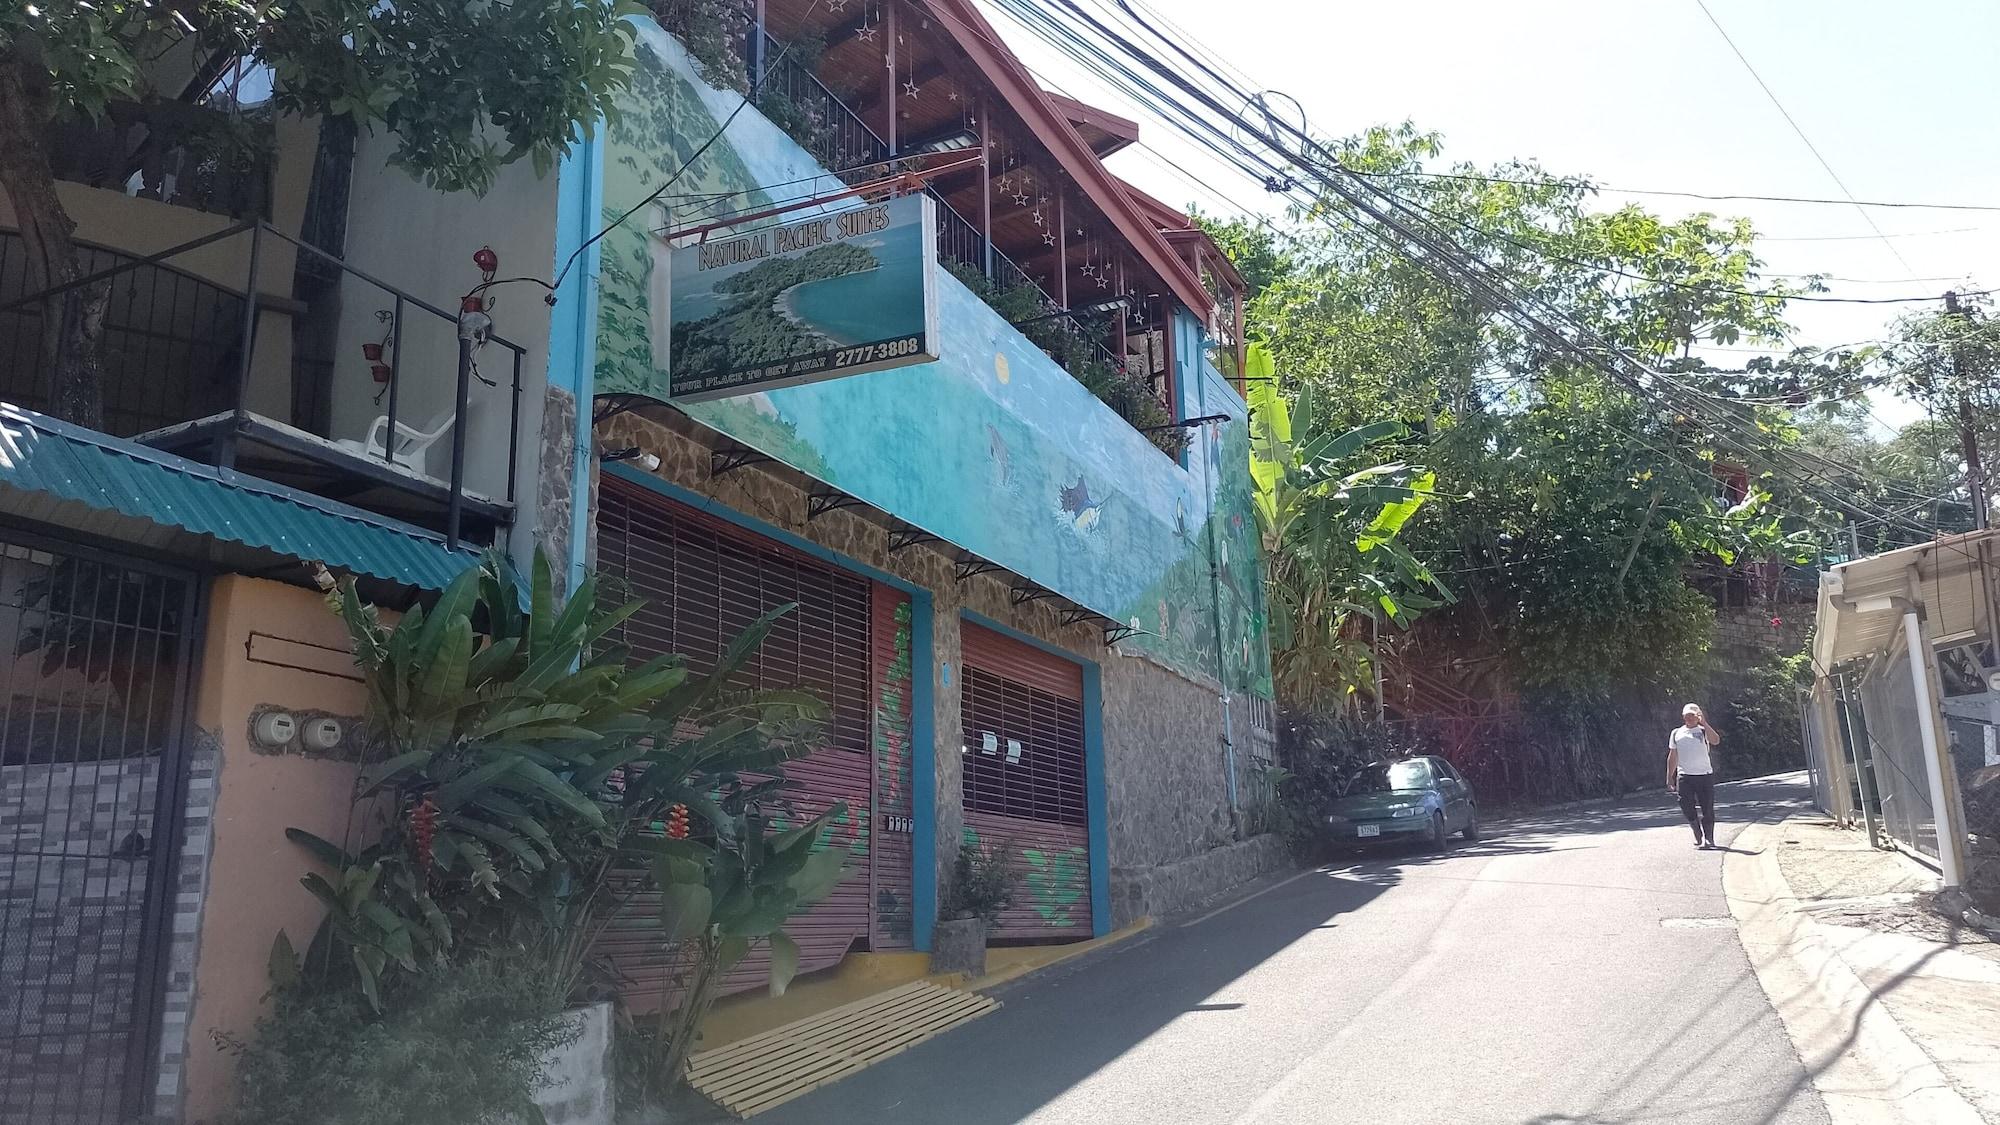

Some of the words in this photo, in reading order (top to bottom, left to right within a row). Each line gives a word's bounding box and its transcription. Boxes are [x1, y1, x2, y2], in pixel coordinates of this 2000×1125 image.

[699, 234, 770, 271] NATURAL
[774, 217, 832, 255] PACIFIC
[837, 204, 890, 239] SUITES
[672, 379, 702, 392] YOUR
[706, 372, 743, 388] PLACE
[747, 368, 762, 380] TO
[765, 364, 788, 377] GET
[792, 357, 827, 372] AWAY
[835, 337, 918, 368] 2777-3808
